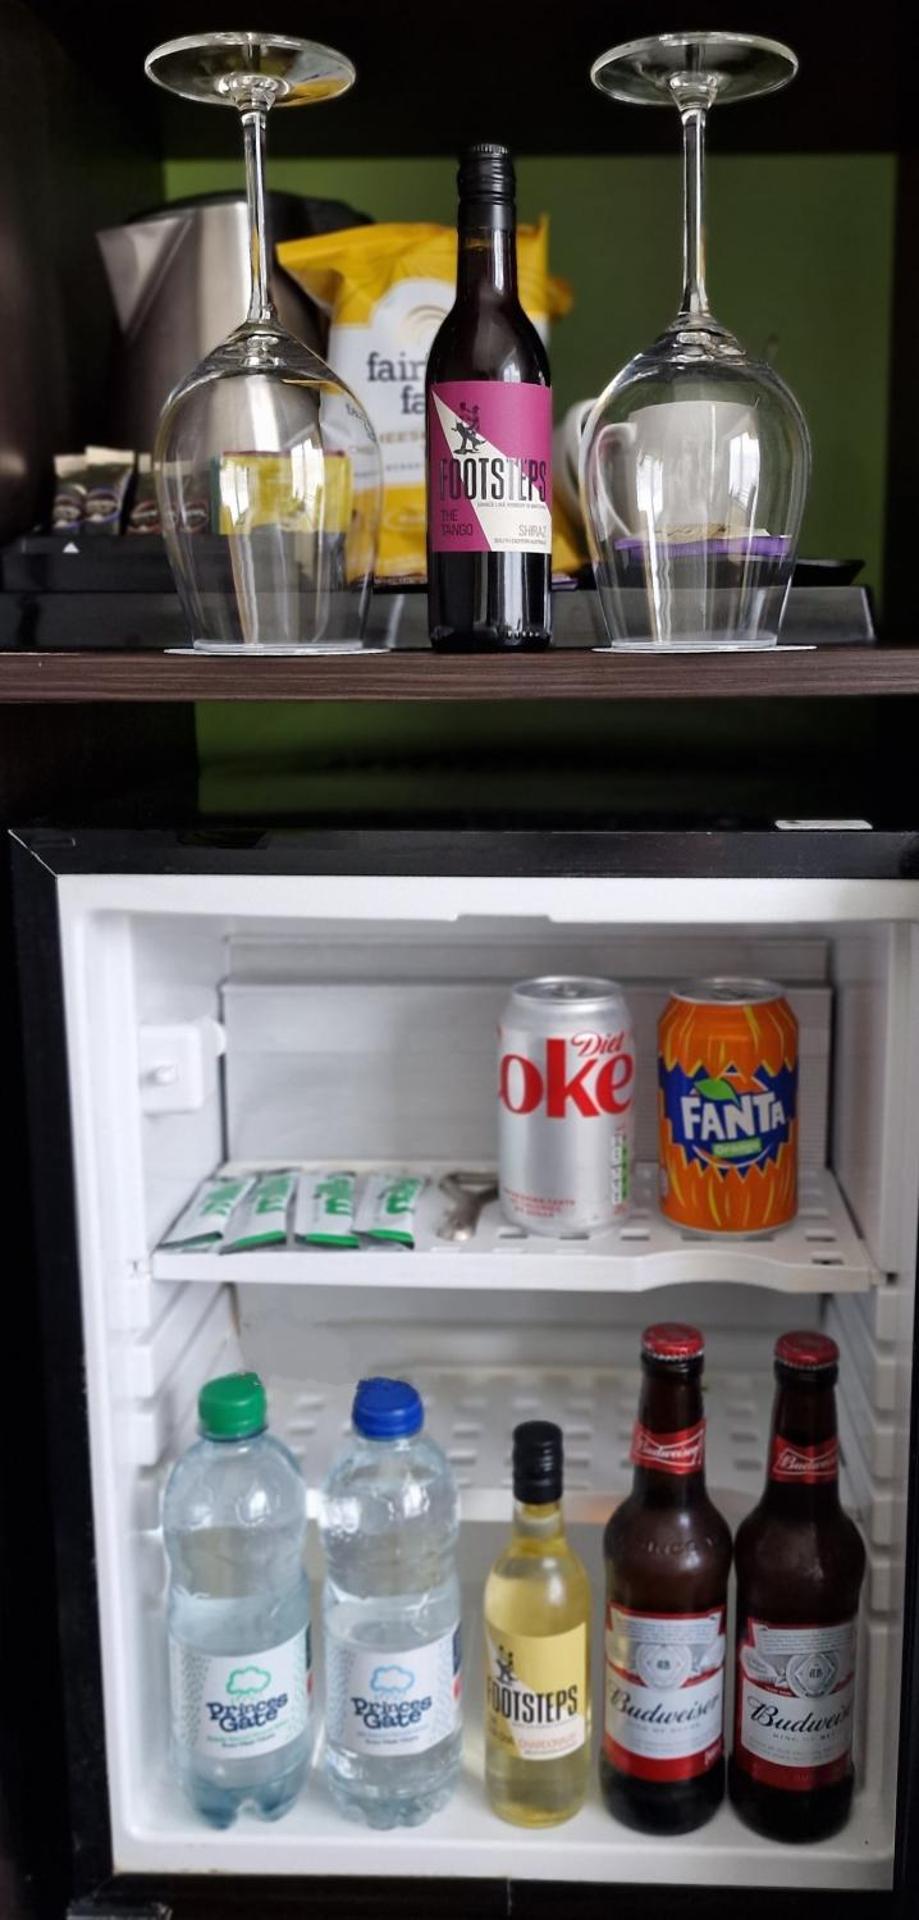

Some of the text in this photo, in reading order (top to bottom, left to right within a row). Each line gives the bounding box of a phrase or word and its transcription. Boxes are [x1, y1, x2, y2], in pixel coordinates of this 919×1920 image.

[440, 457, 547, 502] FOOTSTEPS
[440, 509, 458, 522] THE
[441, 523, 473, 537] TANGO
[519, 524, 547, 537] SHIRAZ
[571, 1031, 626, 1057] Diet
[499, 1038, 634, 1119] oke
[681, 1092, 786, 1141] FANTA
[206, 1693, 288, 1720] Princes
[351, 1696, 432, 1718] Princes
[487, 1676, 578, 1724] FOOTSTEPS
[609, 1685, 720, 1724] Budweiser
[219, 1707, 279, 1733] Gate
[363, 1709, 422, 1731] Gate
